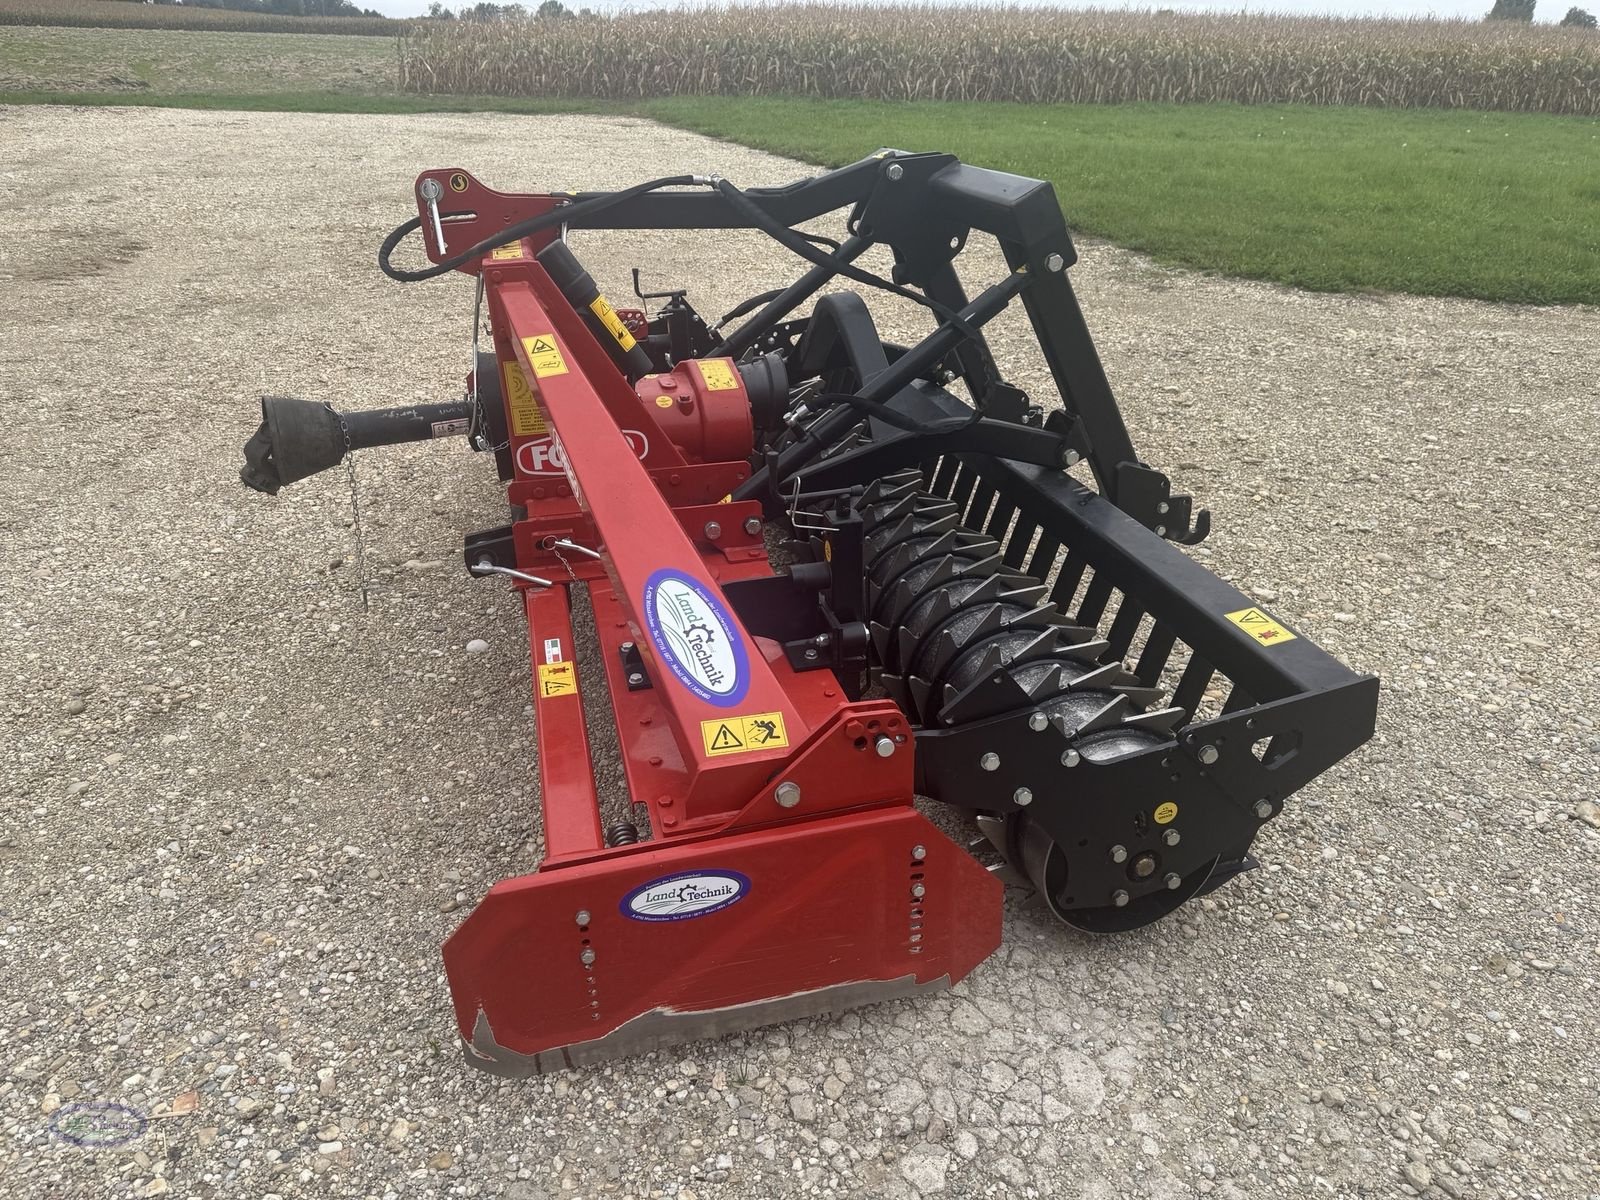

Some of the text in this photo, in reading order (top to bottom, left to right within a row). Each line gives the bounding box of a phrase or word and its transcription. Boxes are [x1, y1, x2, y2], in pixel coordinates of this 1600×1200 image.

[674, 592, 703, 624] Land
[689, 635, 724, 687] Technik
[645, 888, 677, 903] Land
[686, 885, 733, 901] Technik
